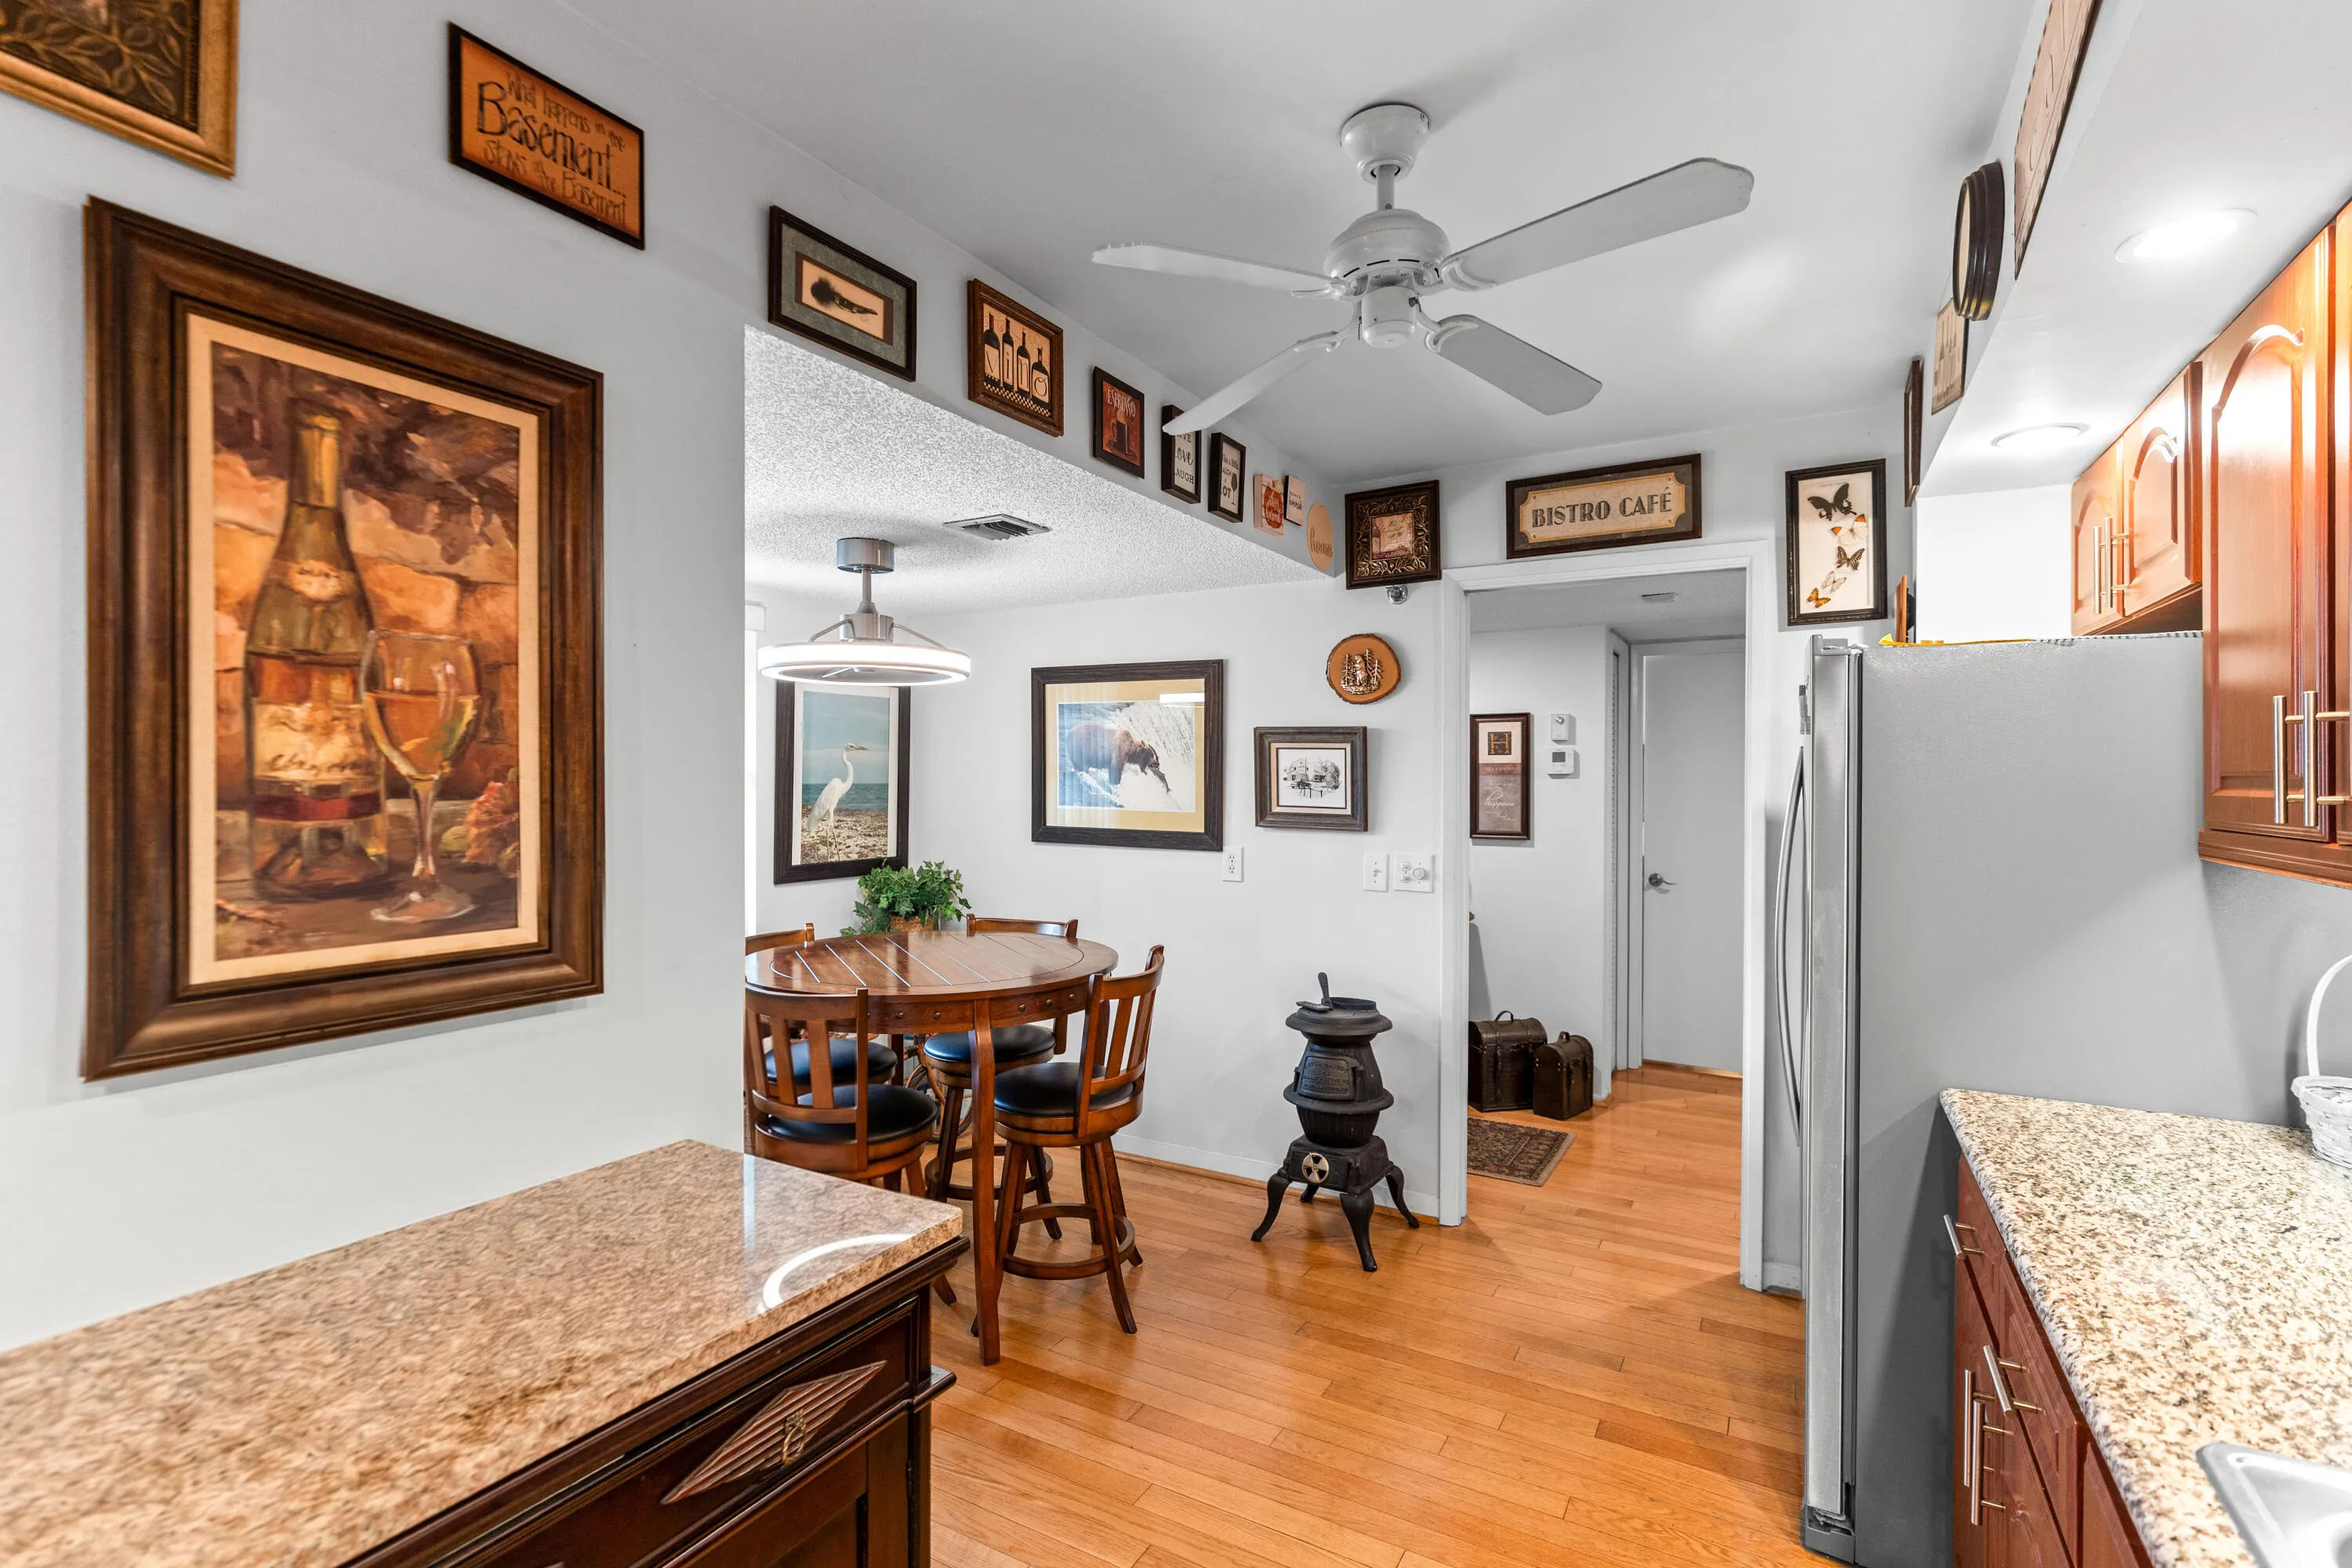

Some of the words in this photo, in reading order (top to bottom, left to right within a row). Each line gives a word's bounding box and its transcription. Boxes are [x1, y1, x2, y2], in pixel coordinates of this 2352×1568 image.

[561, 170, 626, 227] Basement
[1107, 388, 1136, 417] ESPRESSO
[1174, 447, 1194, 466] ove
[1221, 485, 1232, 499] OT
[1532, 500, 1610, 528] BISTRO
[1619, 486, 1671, 517] CAFÉ
[1310, 526, 1333, 558] home
[1490, 733, 1510, 754] H
